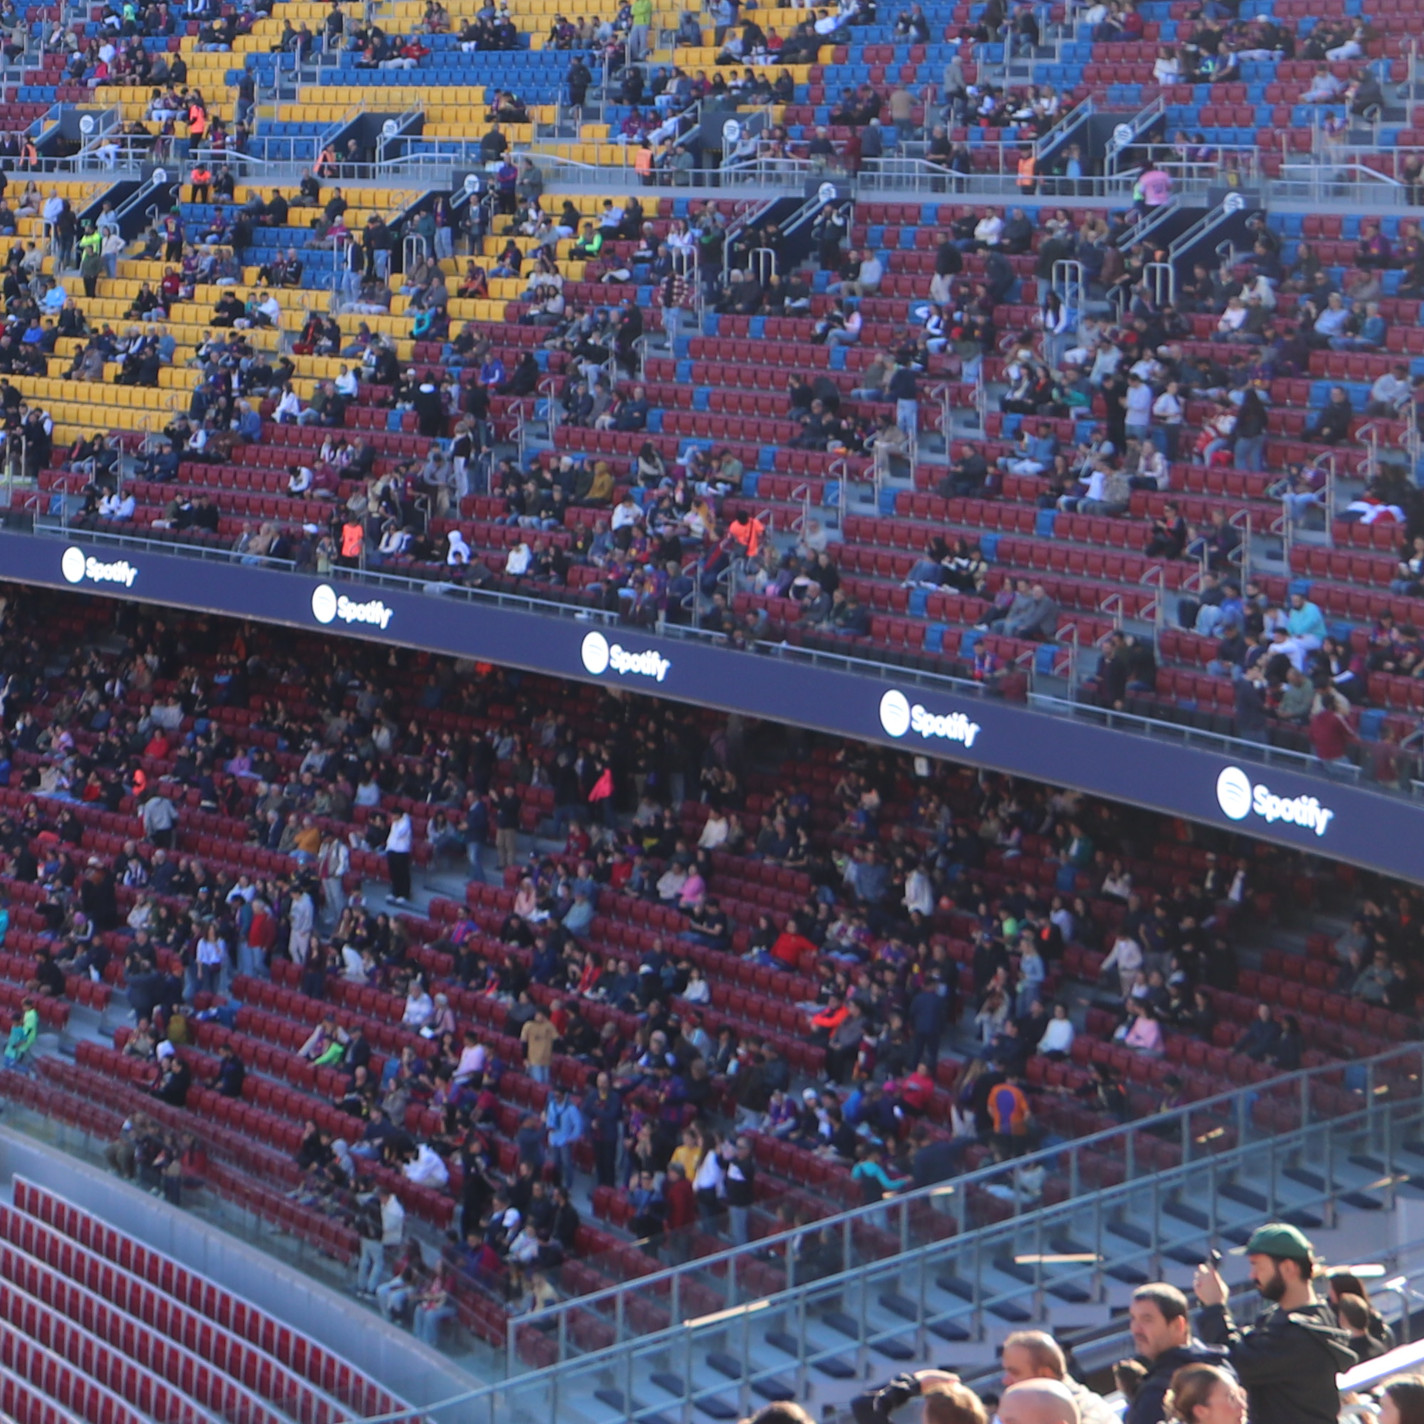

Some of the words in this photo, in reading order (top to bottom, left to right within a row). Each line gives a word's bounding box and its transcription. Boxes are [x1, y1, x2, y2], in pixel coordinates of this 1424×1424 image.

[86, 556, 137, 587] Spotify
[338, 596, 393, 629] Spotify
[609, 644, 671, 682] Spotify
[910, 704, 981, 748] Spotify
[1253, 784, 1334, 836] Spotify
